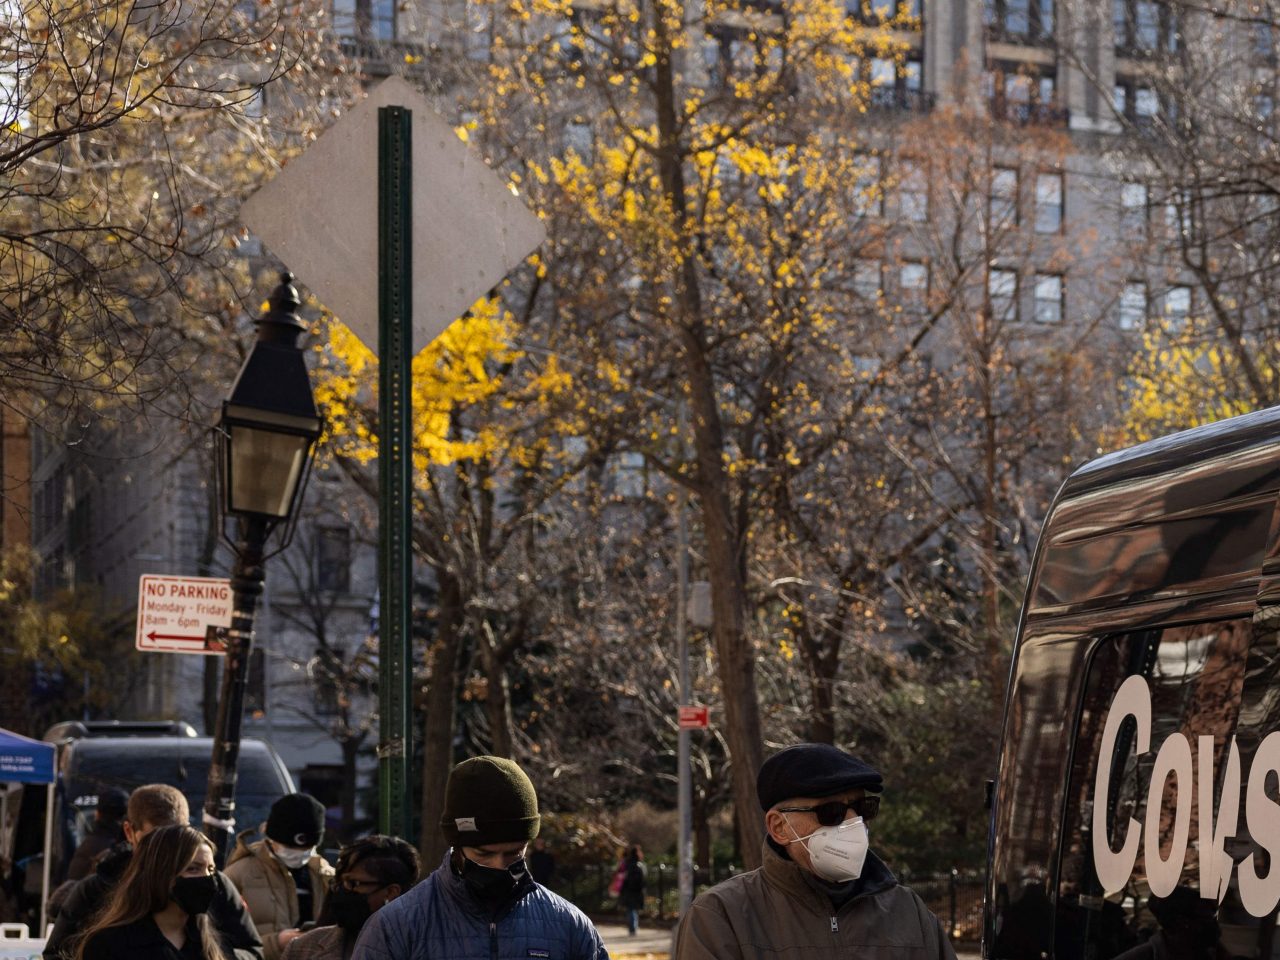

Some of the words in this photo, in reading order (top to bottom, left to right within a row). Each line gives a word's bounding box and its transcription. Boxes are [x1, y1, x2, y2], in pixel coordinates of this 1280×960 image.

[147, 584, 166, 597] NO
[170, 585, 228, 600] PARKING
[147, 601, 186, 614] Monday
[196, 604, 227, 616] Friday
[146, 614, 168, 625] 8am
[178, 616, 200, 629] 6pm
